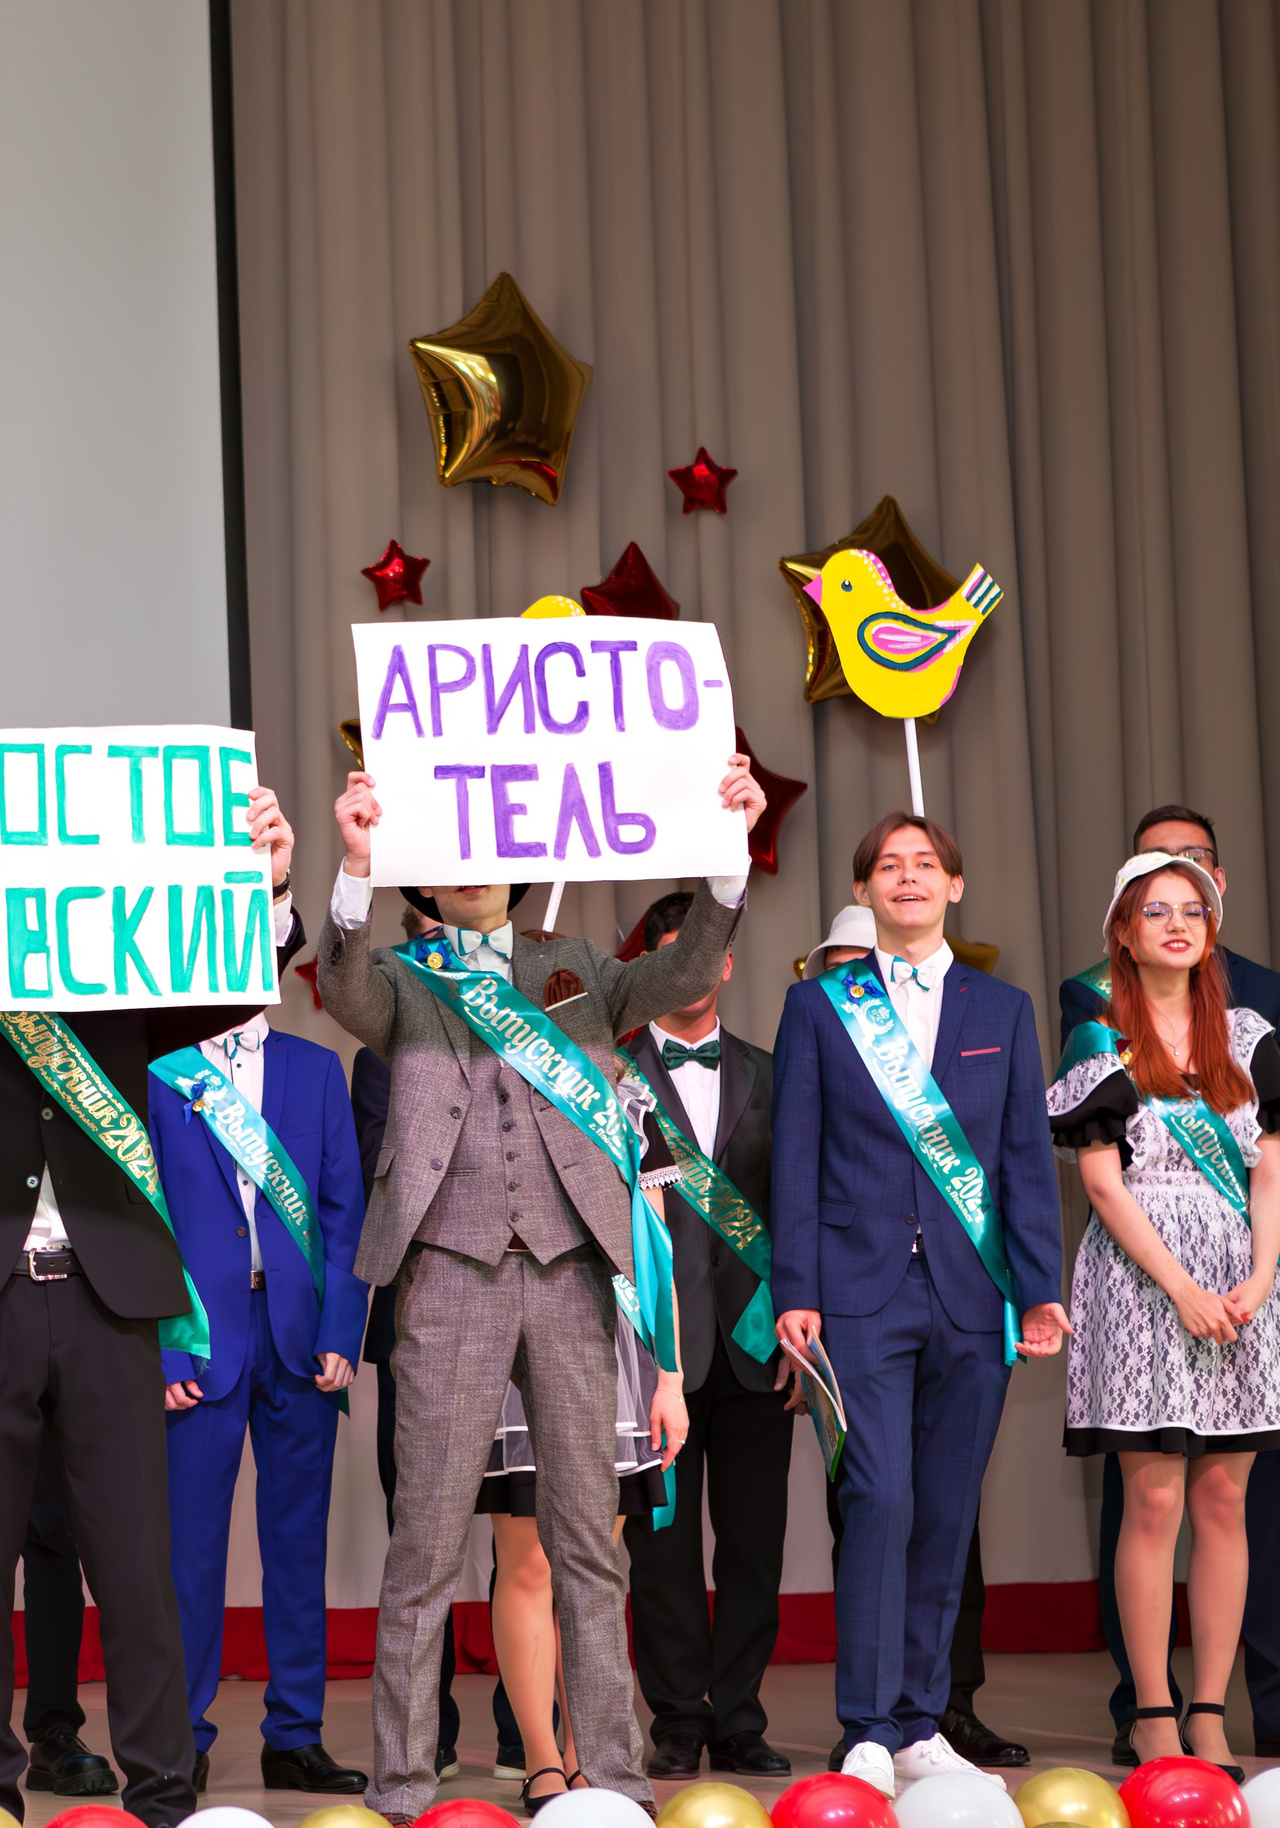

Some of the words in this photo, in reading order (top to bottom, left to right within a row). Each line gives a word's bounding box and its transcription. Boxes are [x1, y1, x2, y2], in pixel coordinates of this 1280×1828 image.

[371, 640, 724, 741] АРИСТО-
[433, 761, 657, 862] ТЕЛЬ
[5, 870, 275, 999] ВСКИЙ
[460, 974, 601, 1112] Выпускник
[98, 1113, 159, 1195] 2024
[220, 1099, 311, 1226] Выпускник
[872, 1035, 961, 1175] Выпускник
[950, 1166, 991, 1224] 2024
[696, 1184, 763, 1250] 2024
